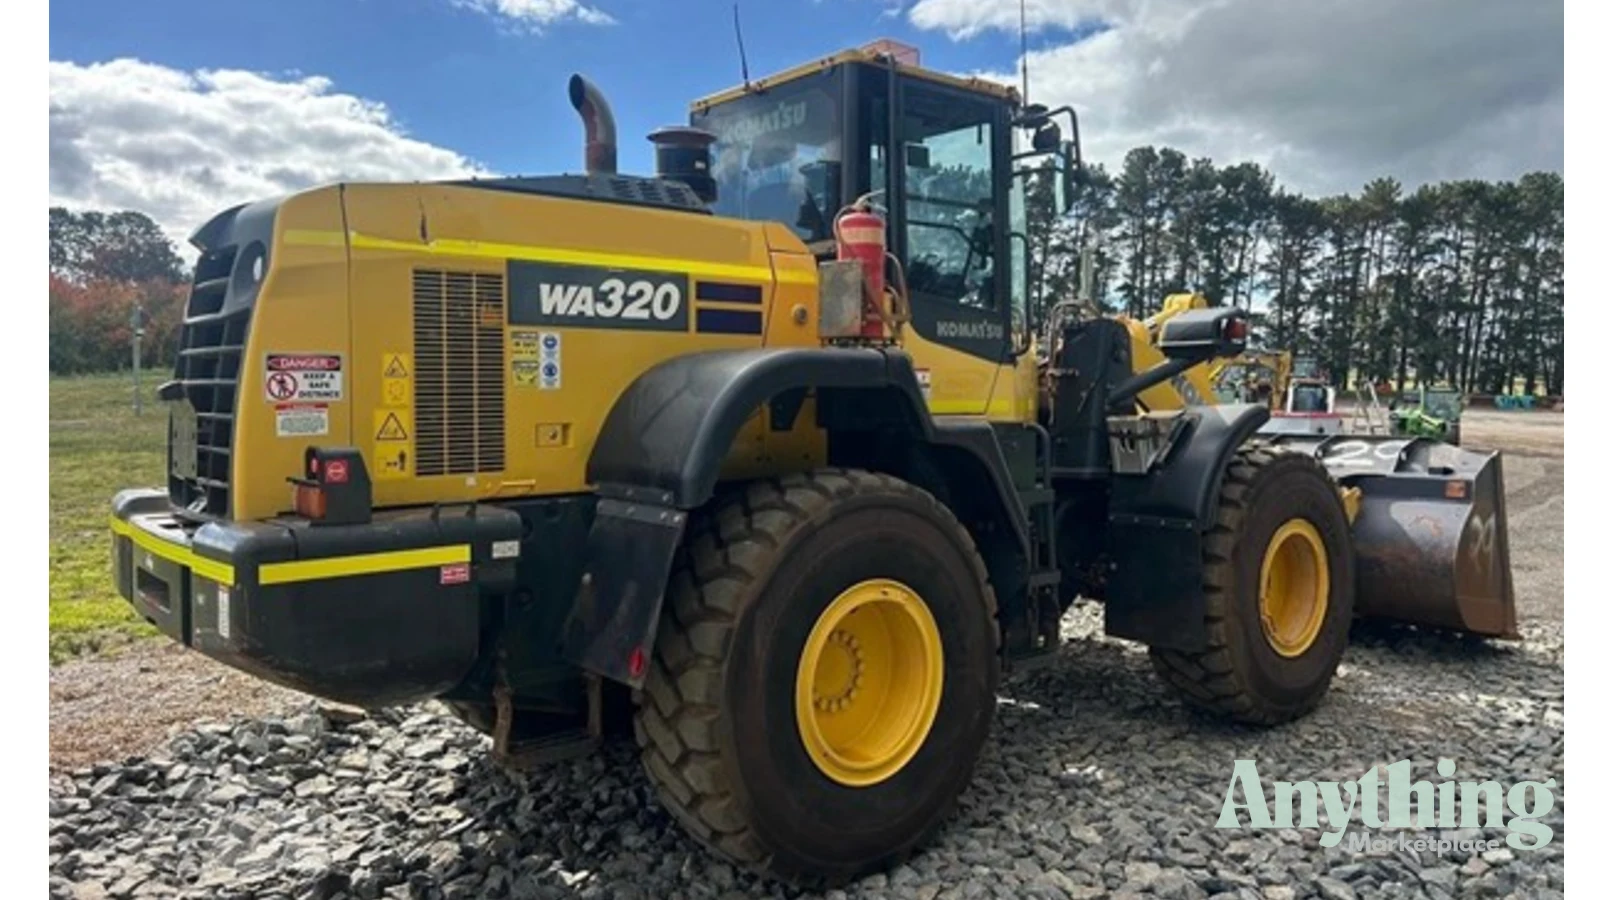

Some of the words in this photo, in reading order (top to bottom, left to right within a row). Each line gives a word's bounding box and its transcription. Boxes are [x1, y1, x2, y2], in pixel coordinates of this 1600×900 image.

[720, 101, 807, 144] KOMATSU
[539, 278, 680, 320] WA320
[936, 319, 1004, 339] KOMATSU
[280, 357, 328, 369] DANGER
